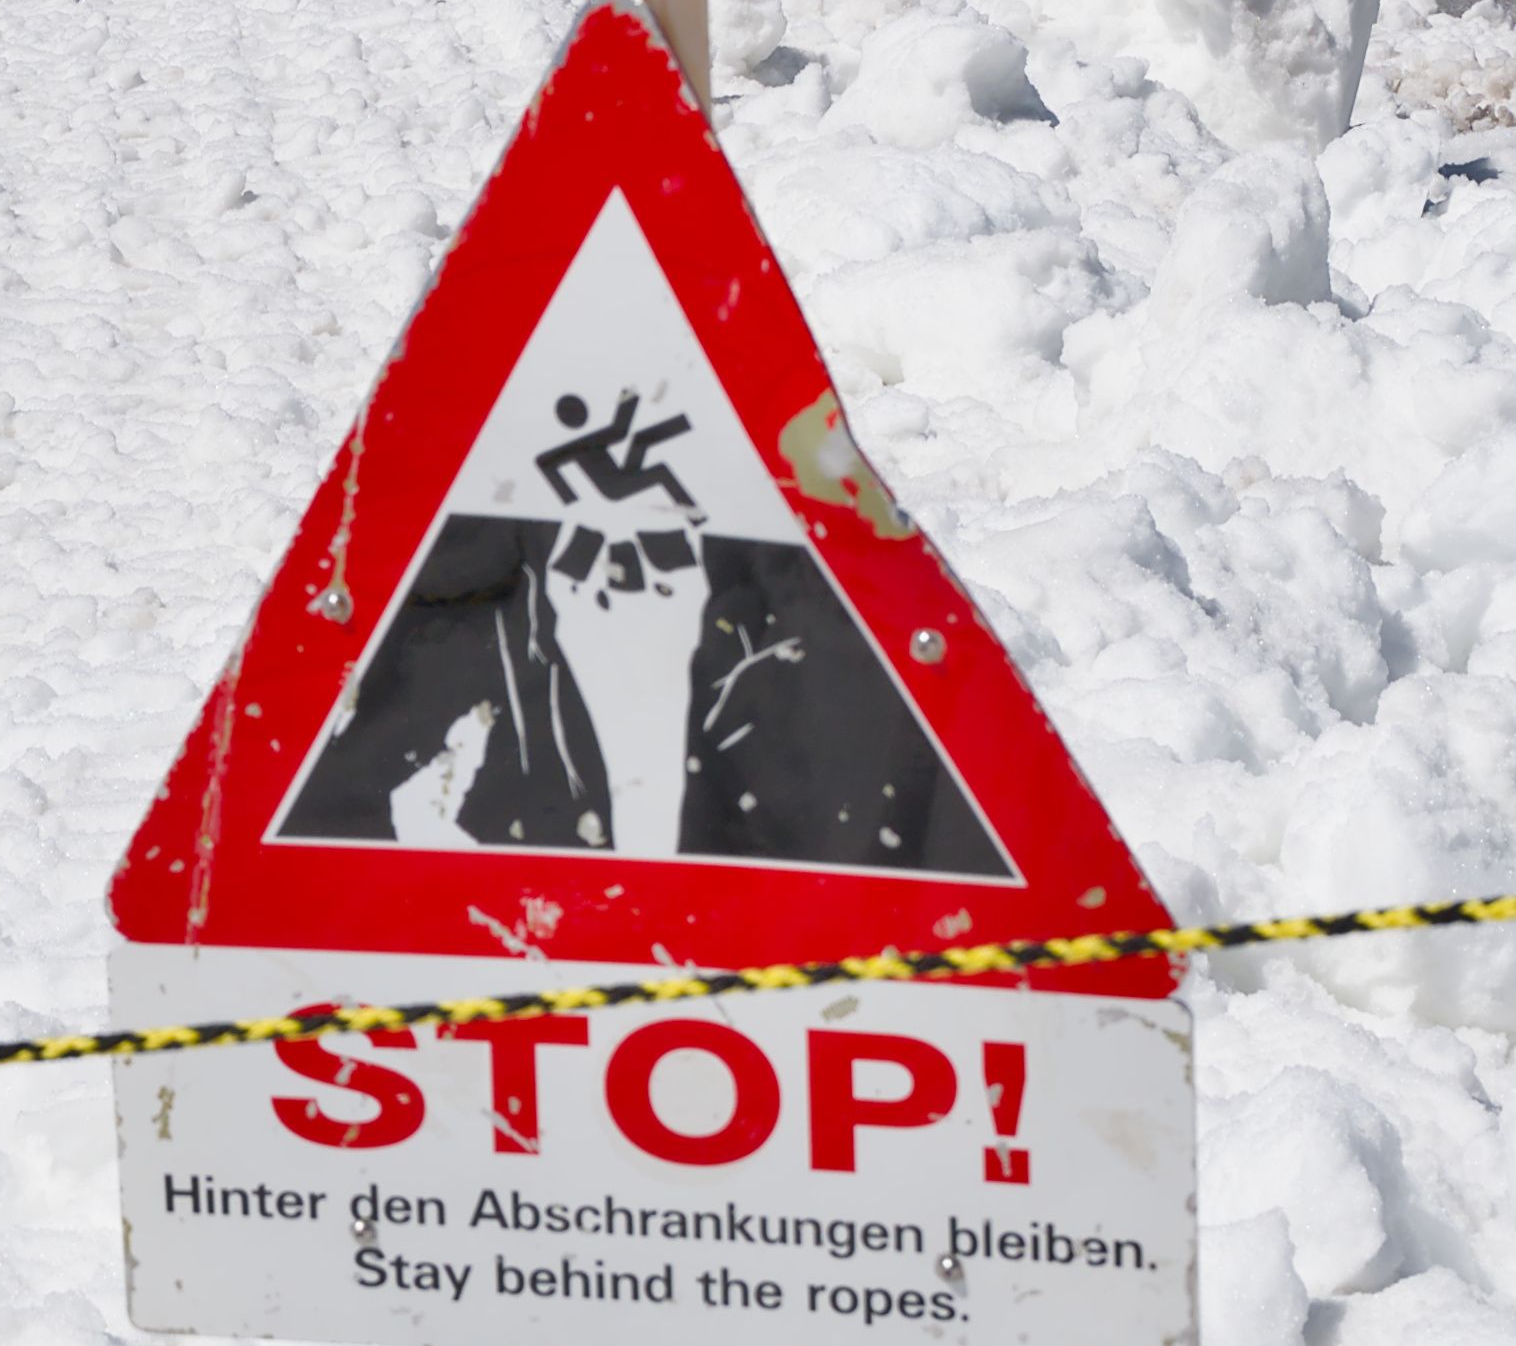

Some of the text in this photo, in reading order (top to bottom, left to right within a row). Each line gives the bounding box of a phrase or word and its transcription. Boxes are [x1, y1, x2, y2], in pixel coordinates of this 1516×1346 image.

[270, 1002, 1031, 1187] STOP!
[163, 1172, 1158, 1273] Hinter den Abschrankungen bleiben.
[353, 1246, 972, 1326] Stay behind the ropes.
